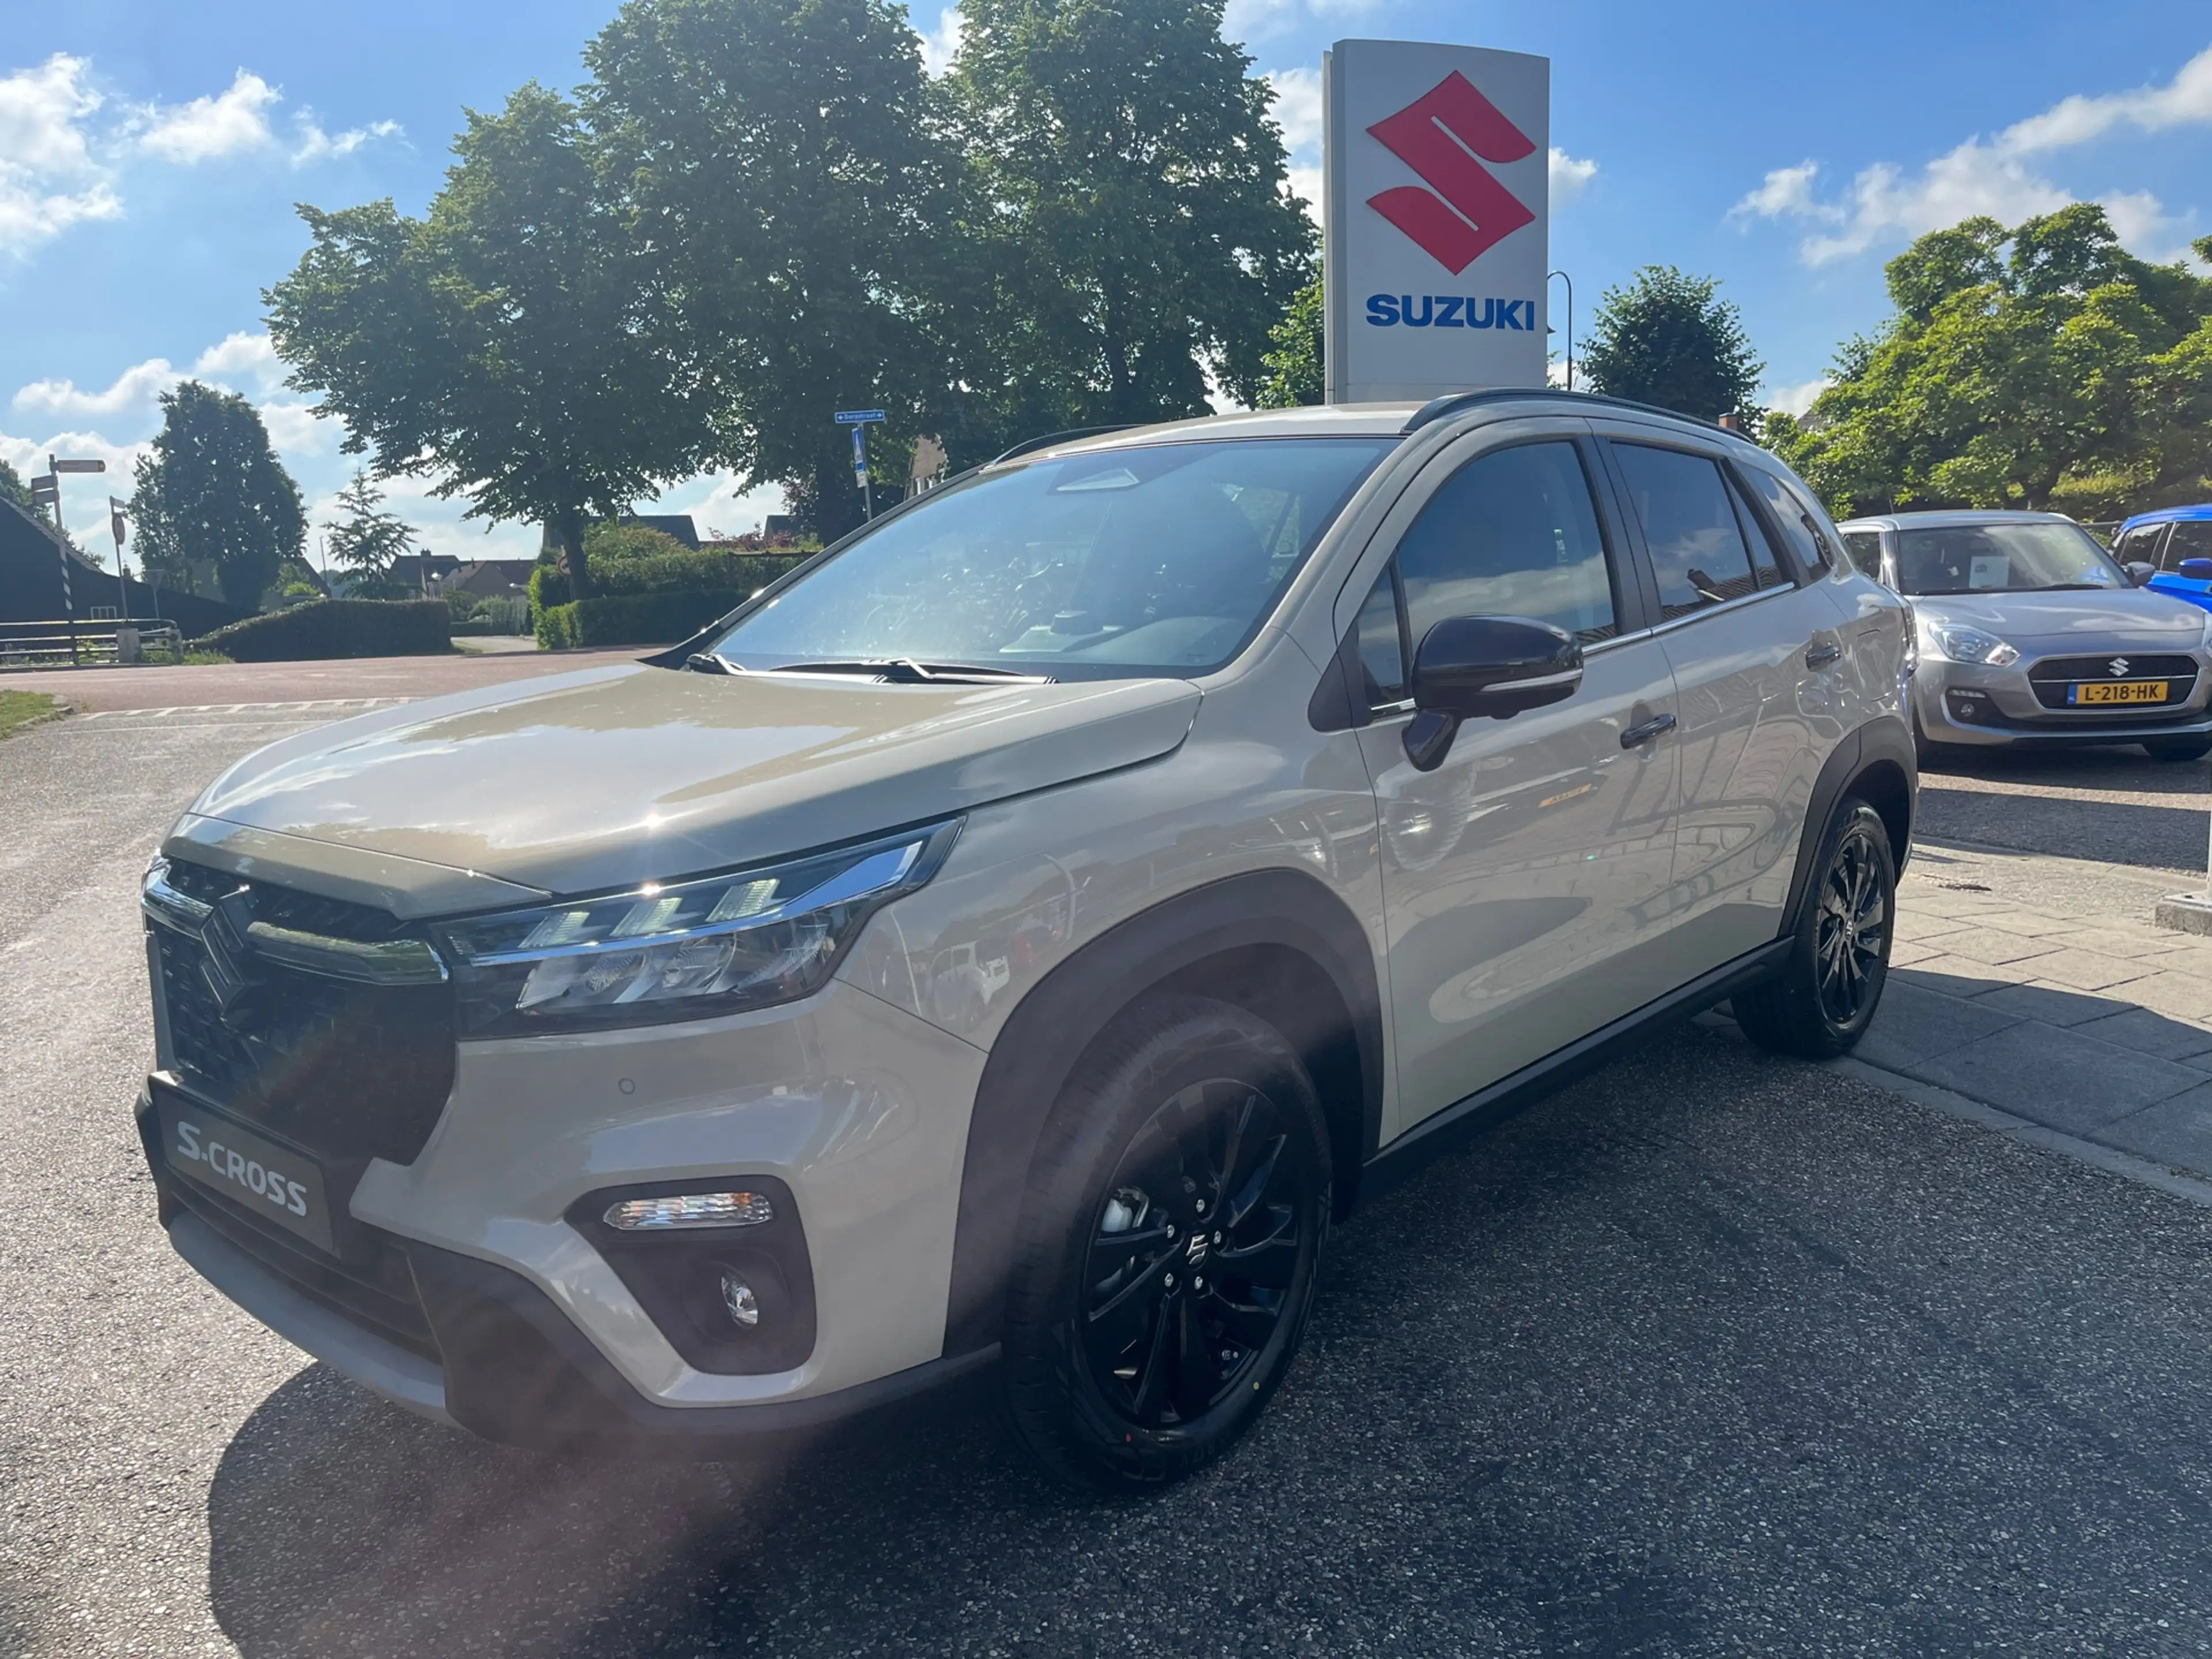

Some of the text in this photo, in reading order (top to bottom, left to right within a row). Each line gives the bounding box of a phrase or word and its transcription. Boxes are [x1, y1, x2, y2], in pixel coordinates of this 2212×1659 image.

[1366, 294, 1534, 331] SUZUKI
[2085, 684, 2159, 701] L-218-HK
[177, 1120, 307, 1217] S.CROSS
